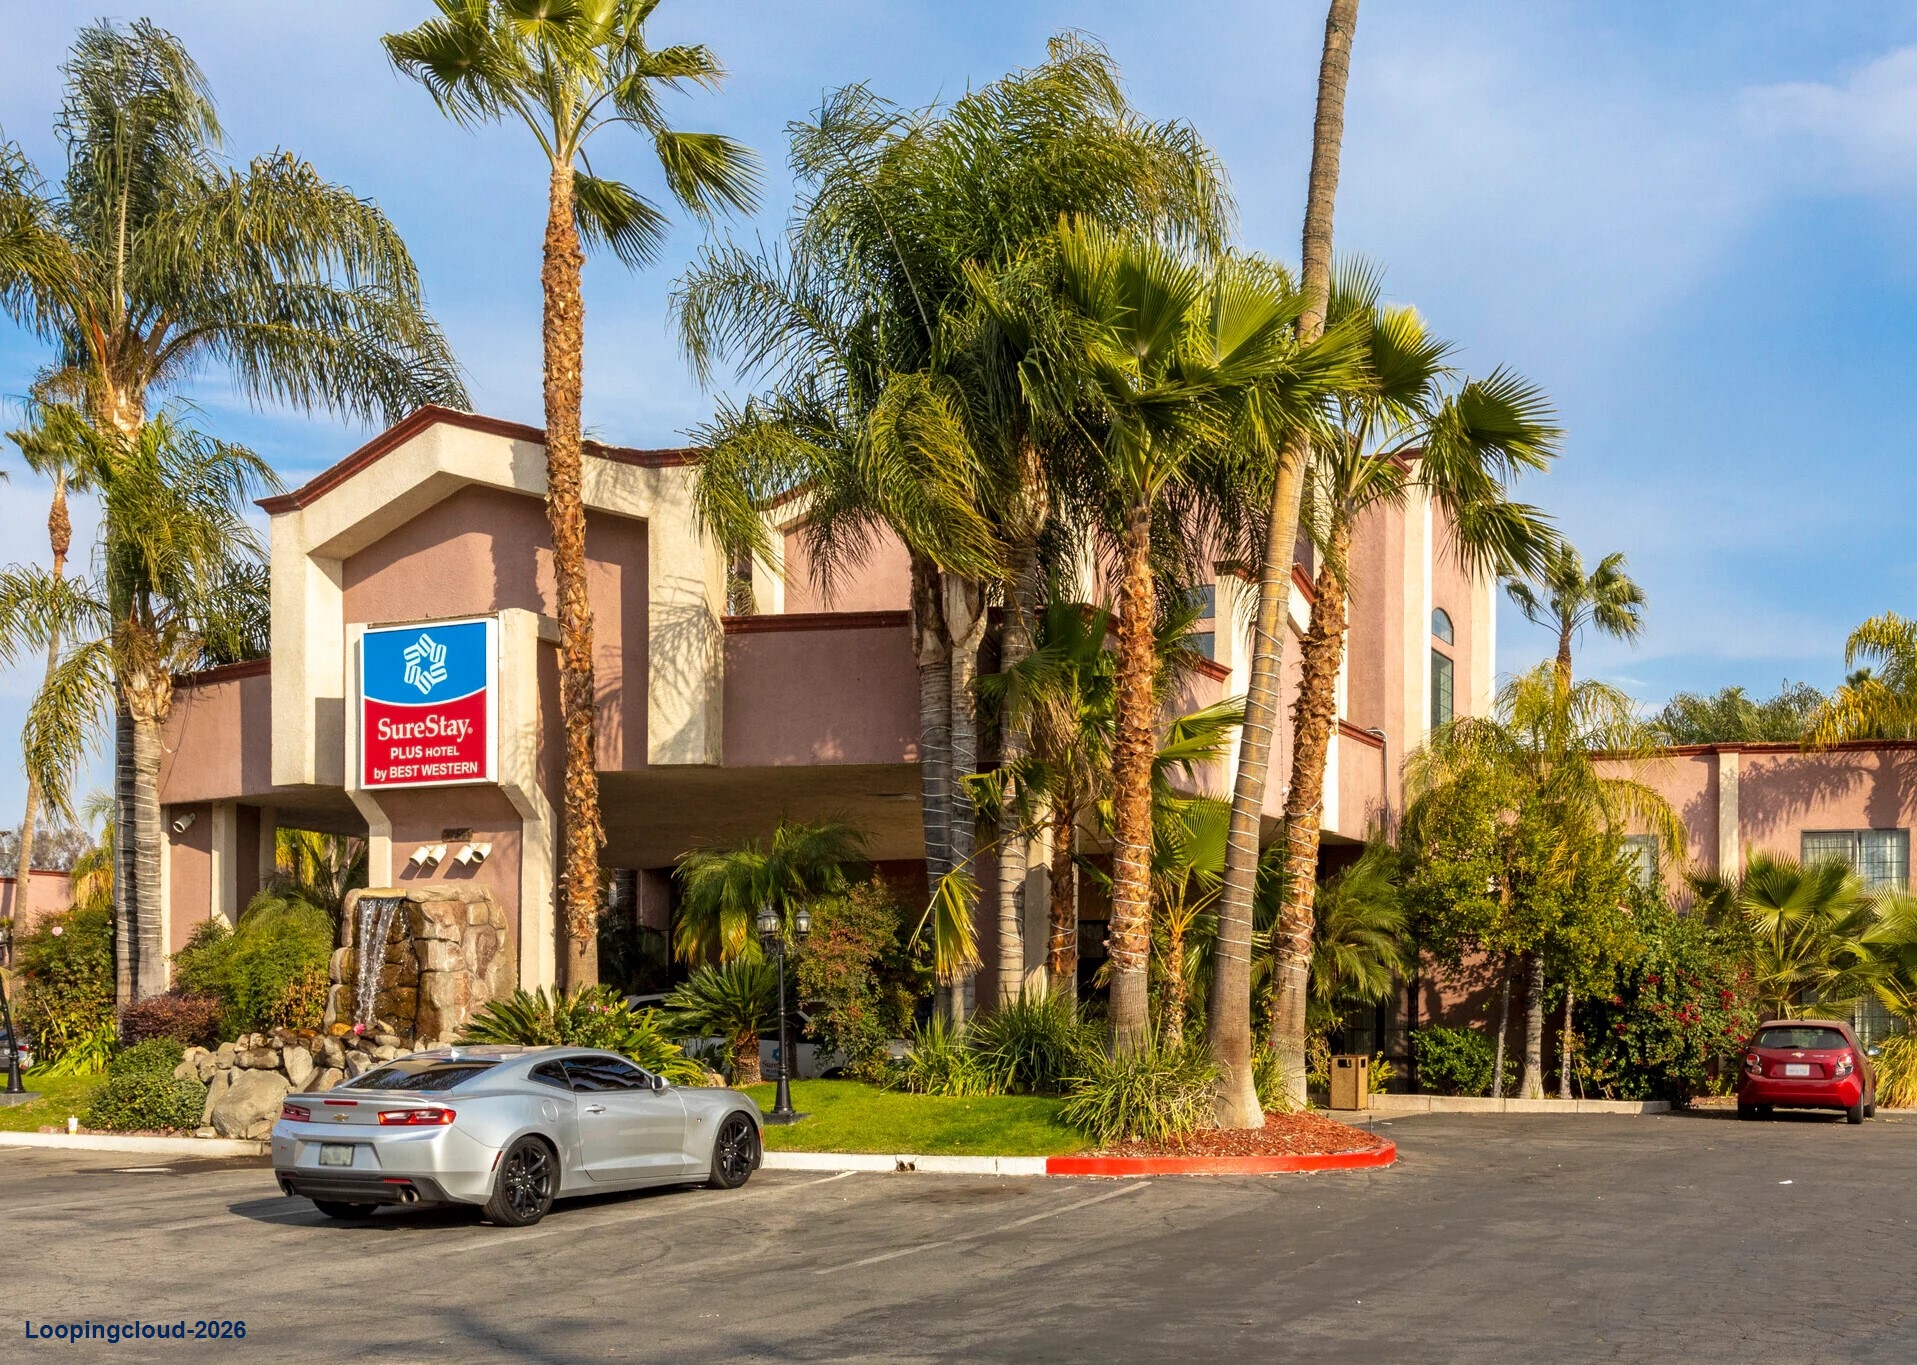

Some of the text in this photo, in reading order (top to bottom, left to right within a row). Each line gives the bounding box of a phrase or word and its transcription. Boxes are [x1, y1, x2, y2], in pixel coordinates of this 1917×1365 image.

[378, 714, 470, 742] SureStay
[390, 746, 460, 760] PLUS HOTEL
[373, 761, 478, 781] by BEST WESTERN
